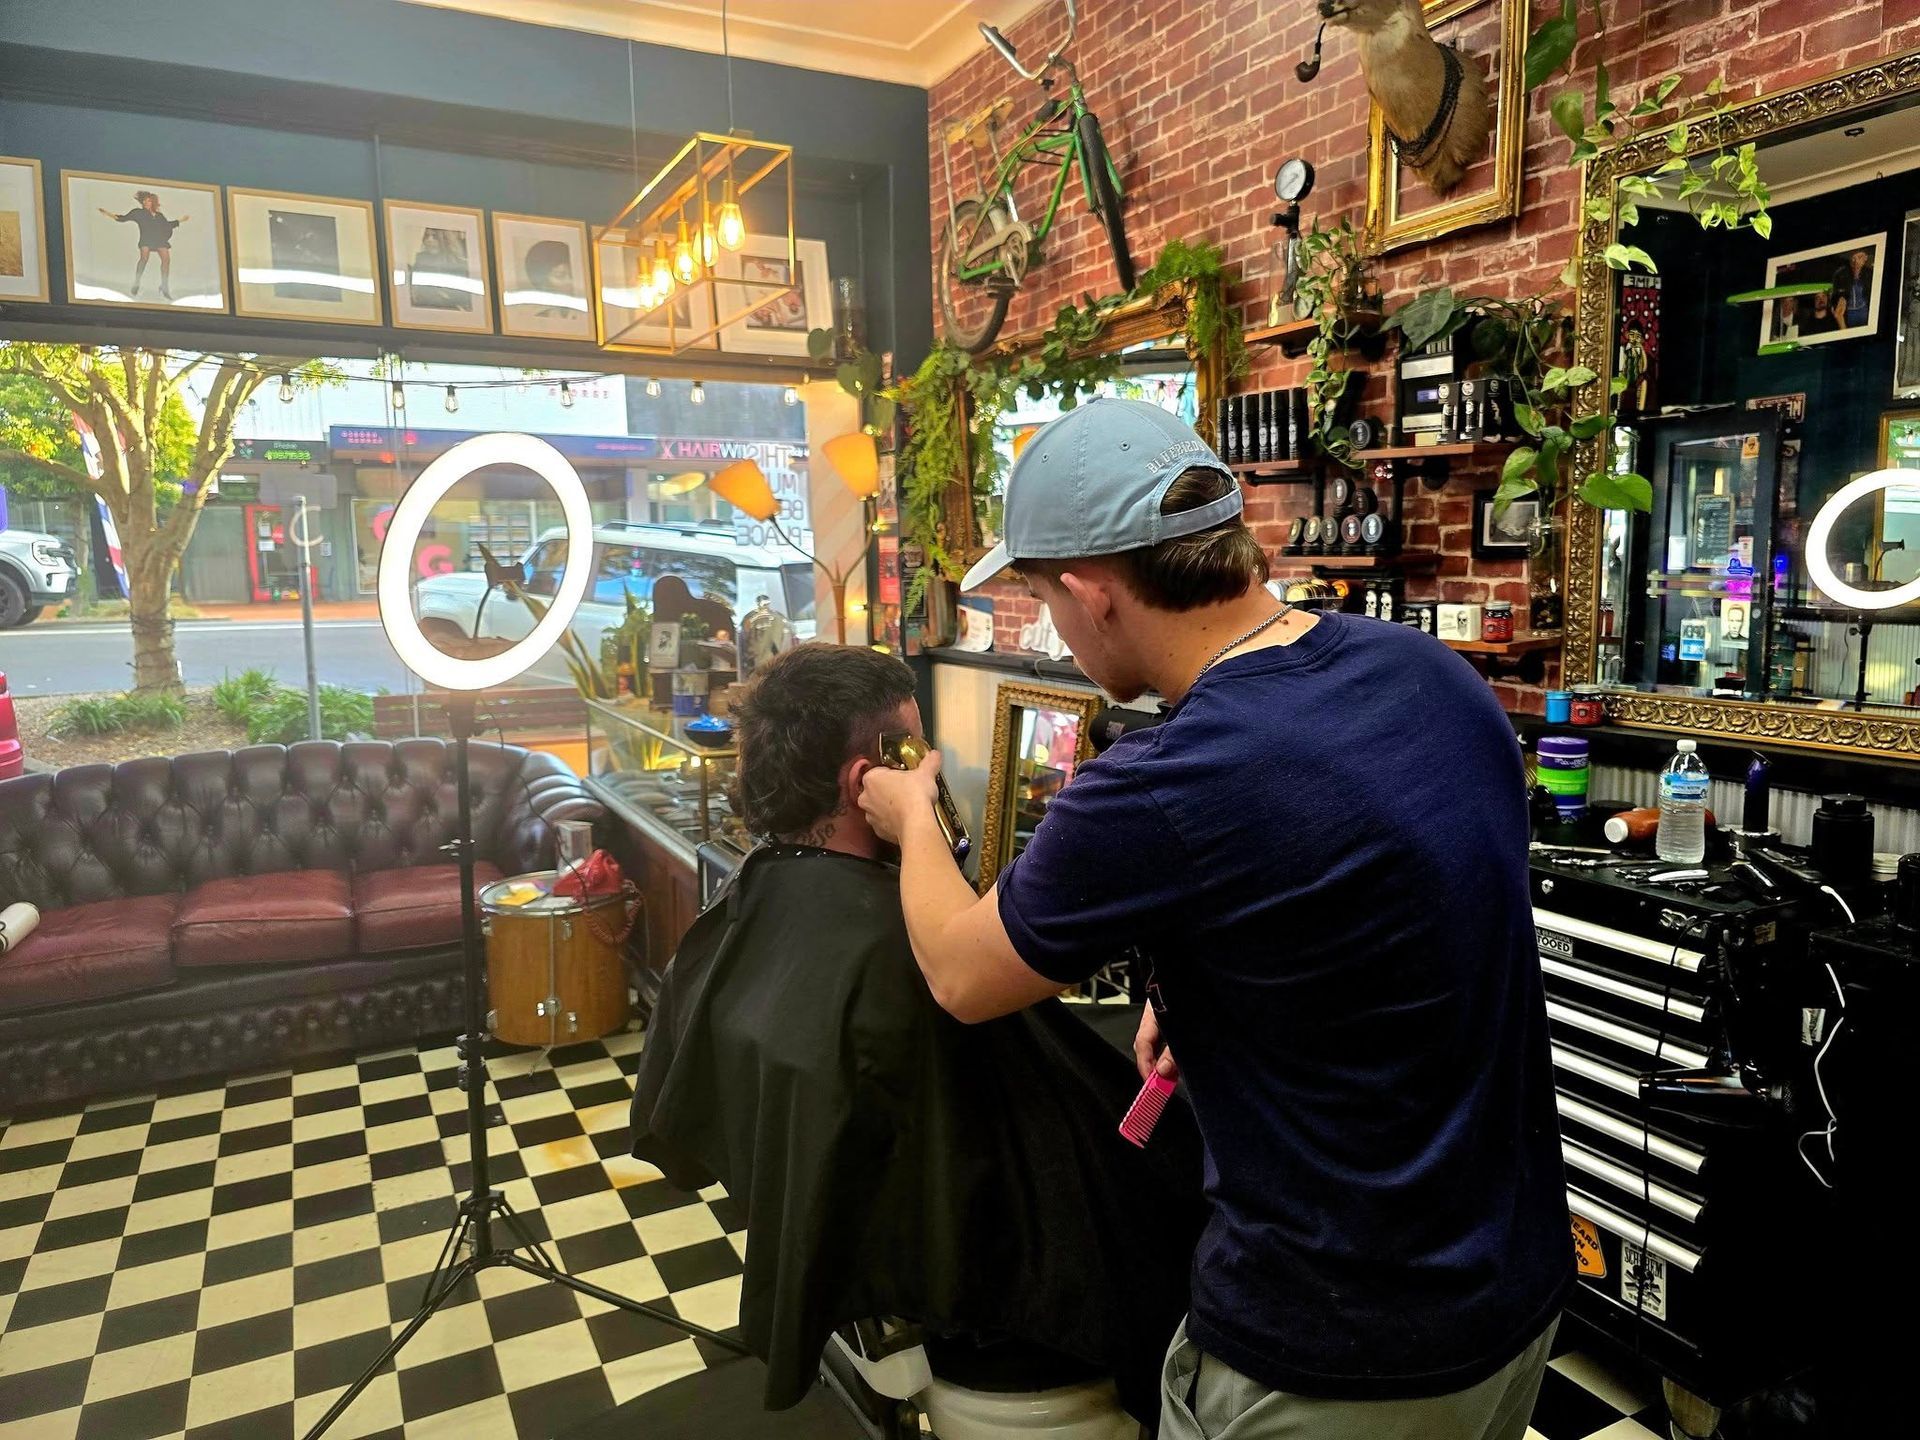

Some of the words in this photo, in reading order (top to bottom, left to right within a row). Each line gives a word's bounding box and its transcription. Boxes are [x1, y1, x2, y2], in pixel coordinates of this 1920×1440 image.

[1538, 936, 1570, 952] TOOED
[1573, 1222, 1598, 1250] EARD
[1625, 1246, 1663, 1280] SCHREM
